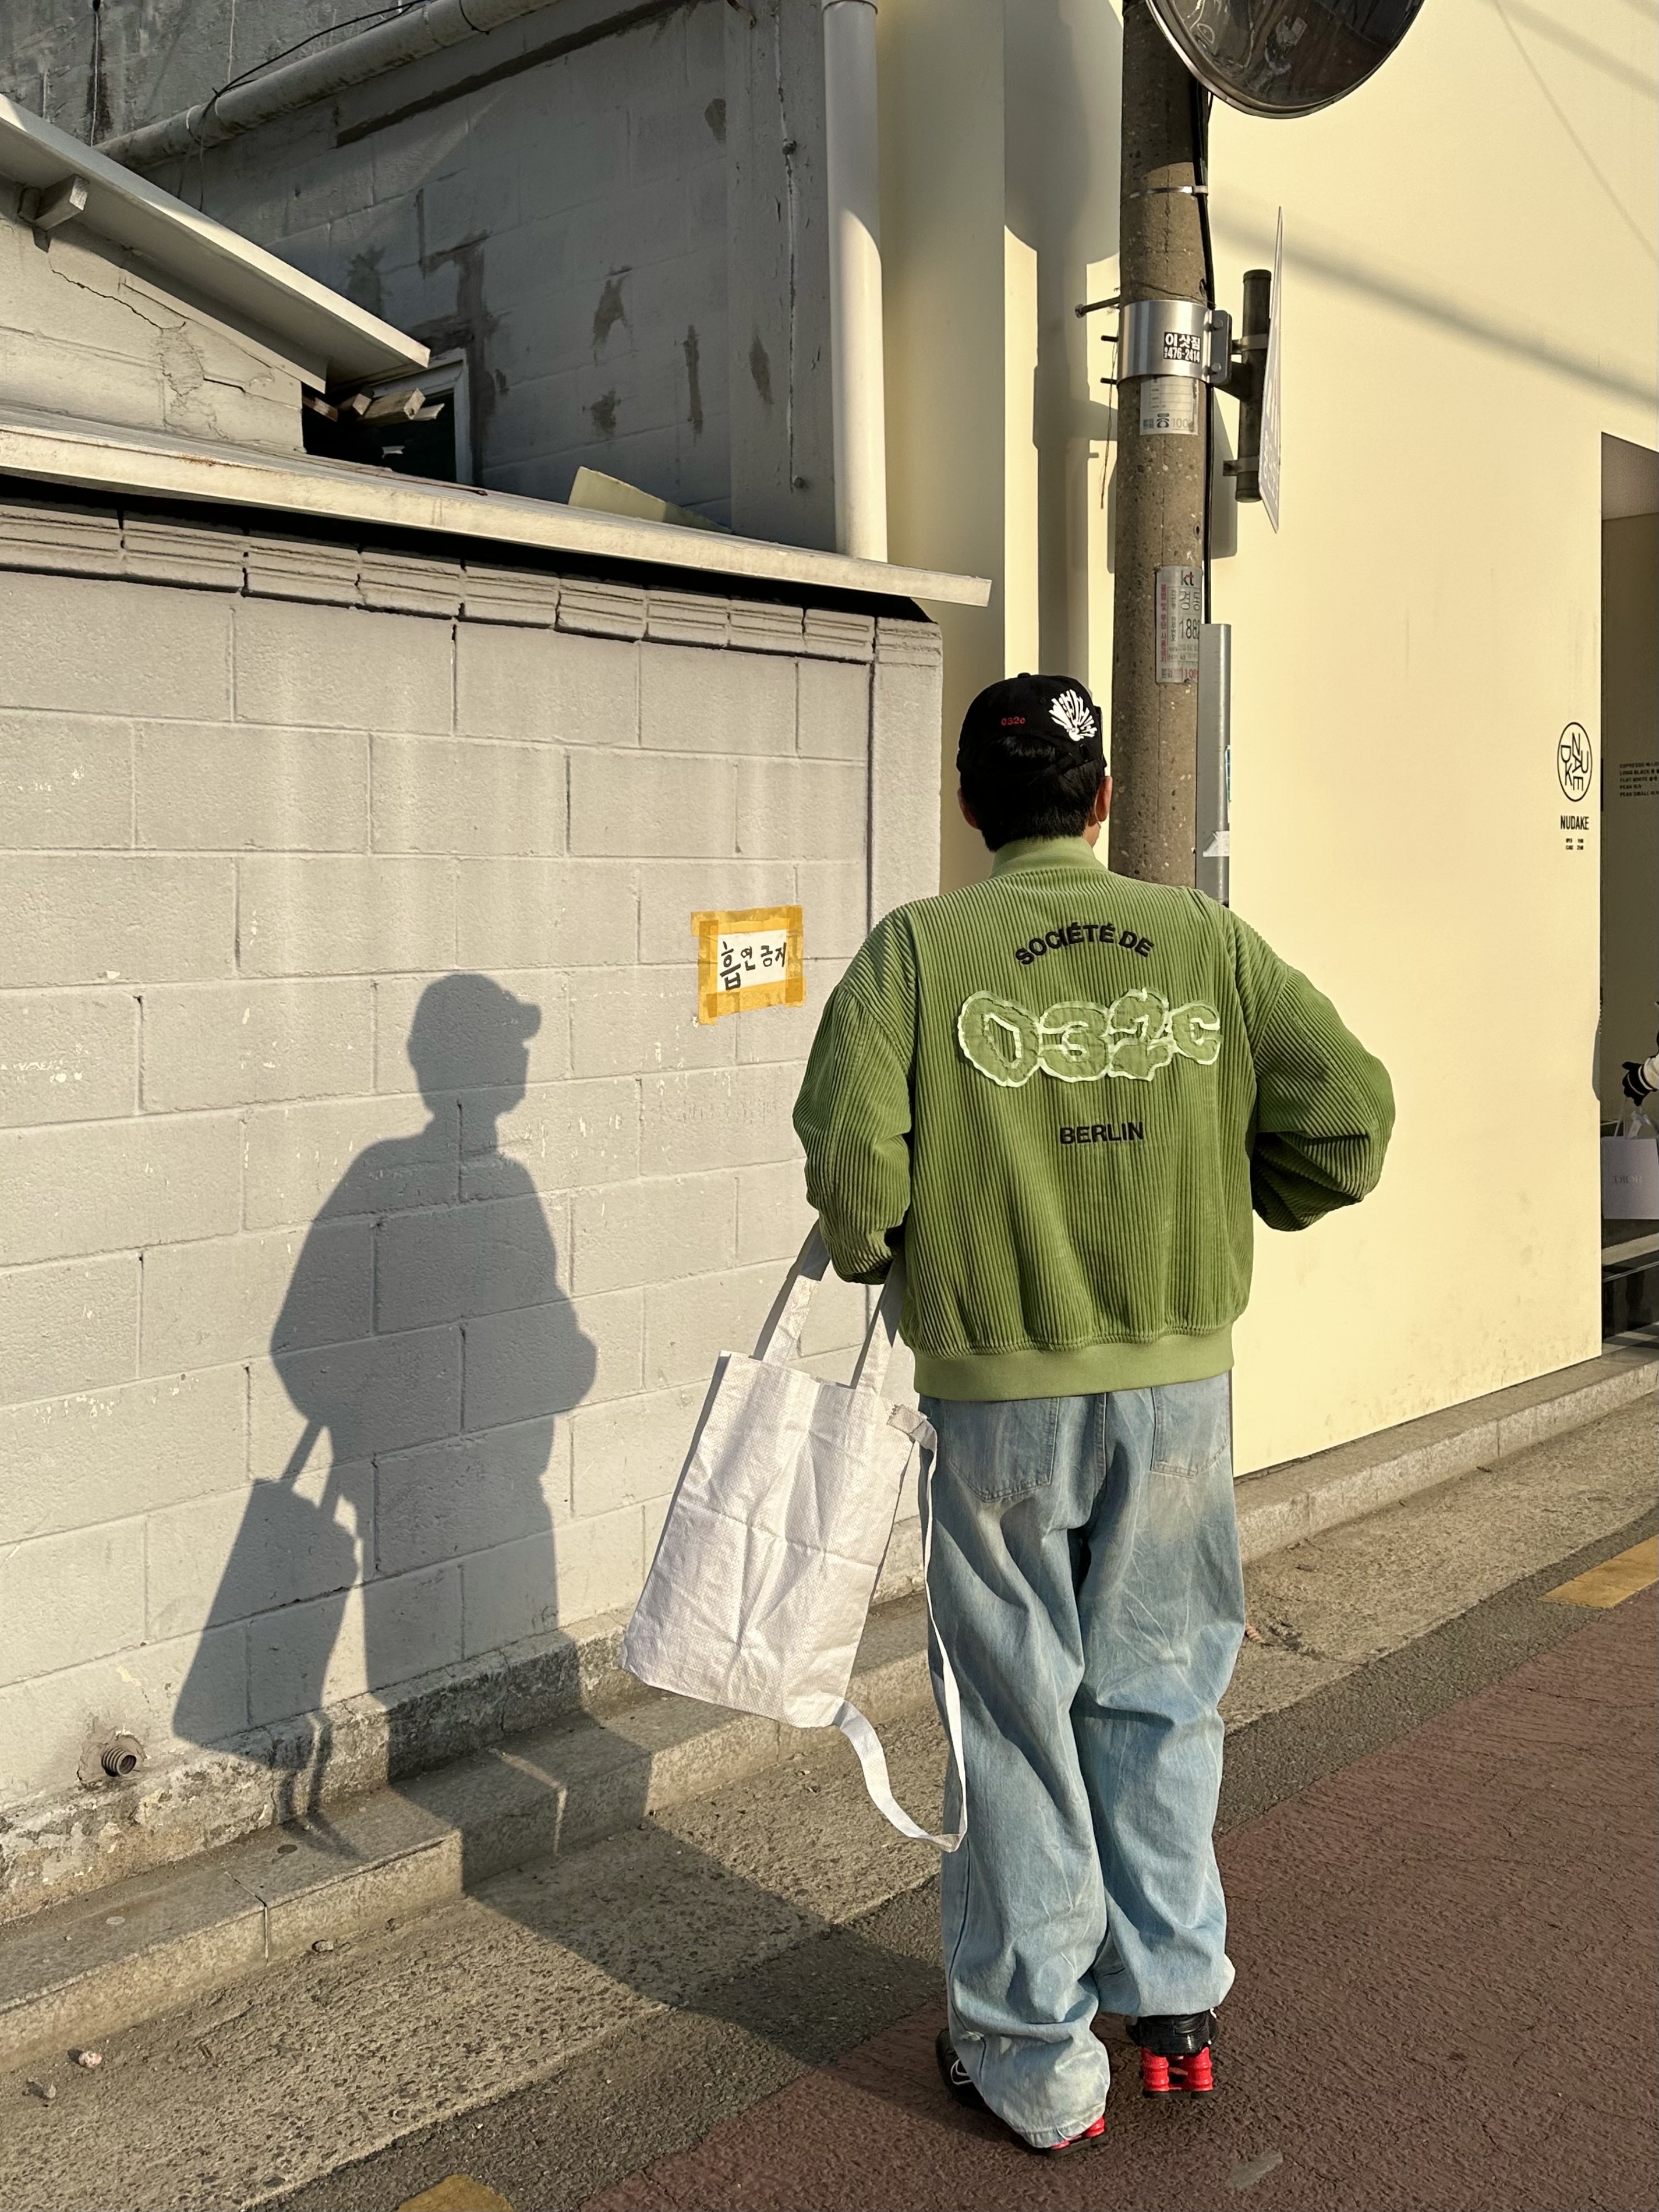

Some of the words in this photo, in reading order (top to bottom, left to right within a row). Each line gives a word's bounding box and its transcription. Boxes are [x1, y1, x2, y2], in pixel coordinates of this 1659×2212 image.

[1165, 333, 1200, 350] 이삿짐
[1181, 570, 1194, 586] kt
[1561, 815, 1589, 830] NUDAKE
[1015, 922, 1116, 965] SOCIÉTÉ
[1119, 930, 1155, 958] DE
[1059, 1121, 1144, 1144] BERLIN
